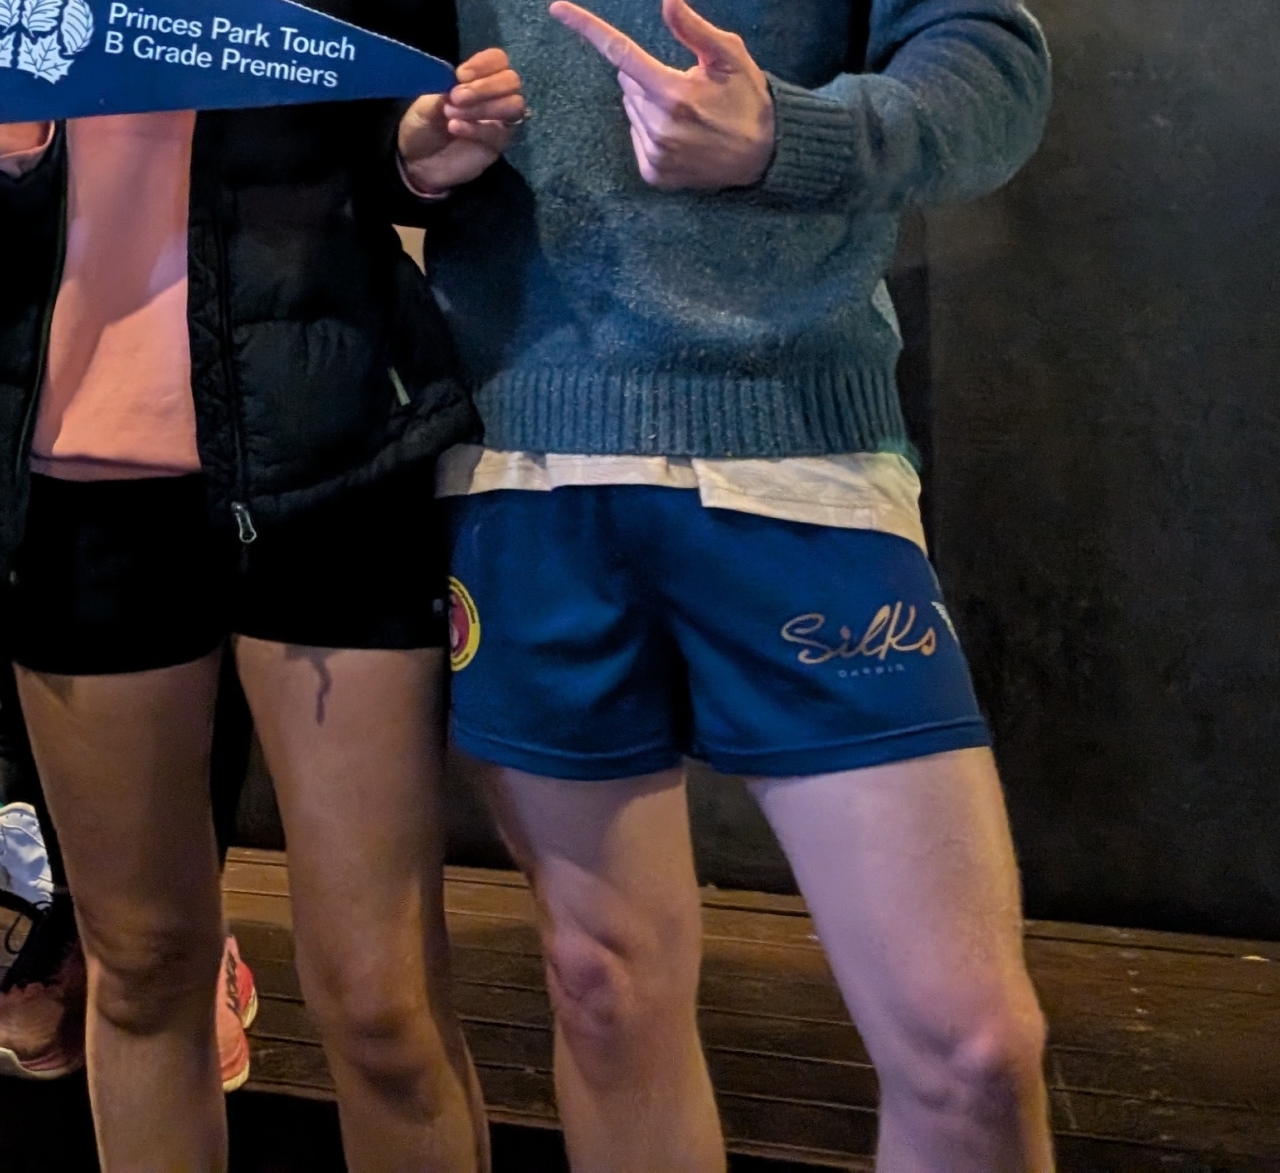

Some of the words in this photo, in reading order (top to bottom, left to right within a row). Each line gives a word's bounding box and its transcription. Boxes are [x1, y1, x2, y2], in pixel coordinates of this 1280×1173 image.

[105, 31, 124, 54] B
[133, 35, 213, 69] Grade
[221, 48, 338, 88] Premiers
[108, 2, 203, 38] Princes
[211, 17, 270, 49] Park
[280, 26, 355, 61] Touch
